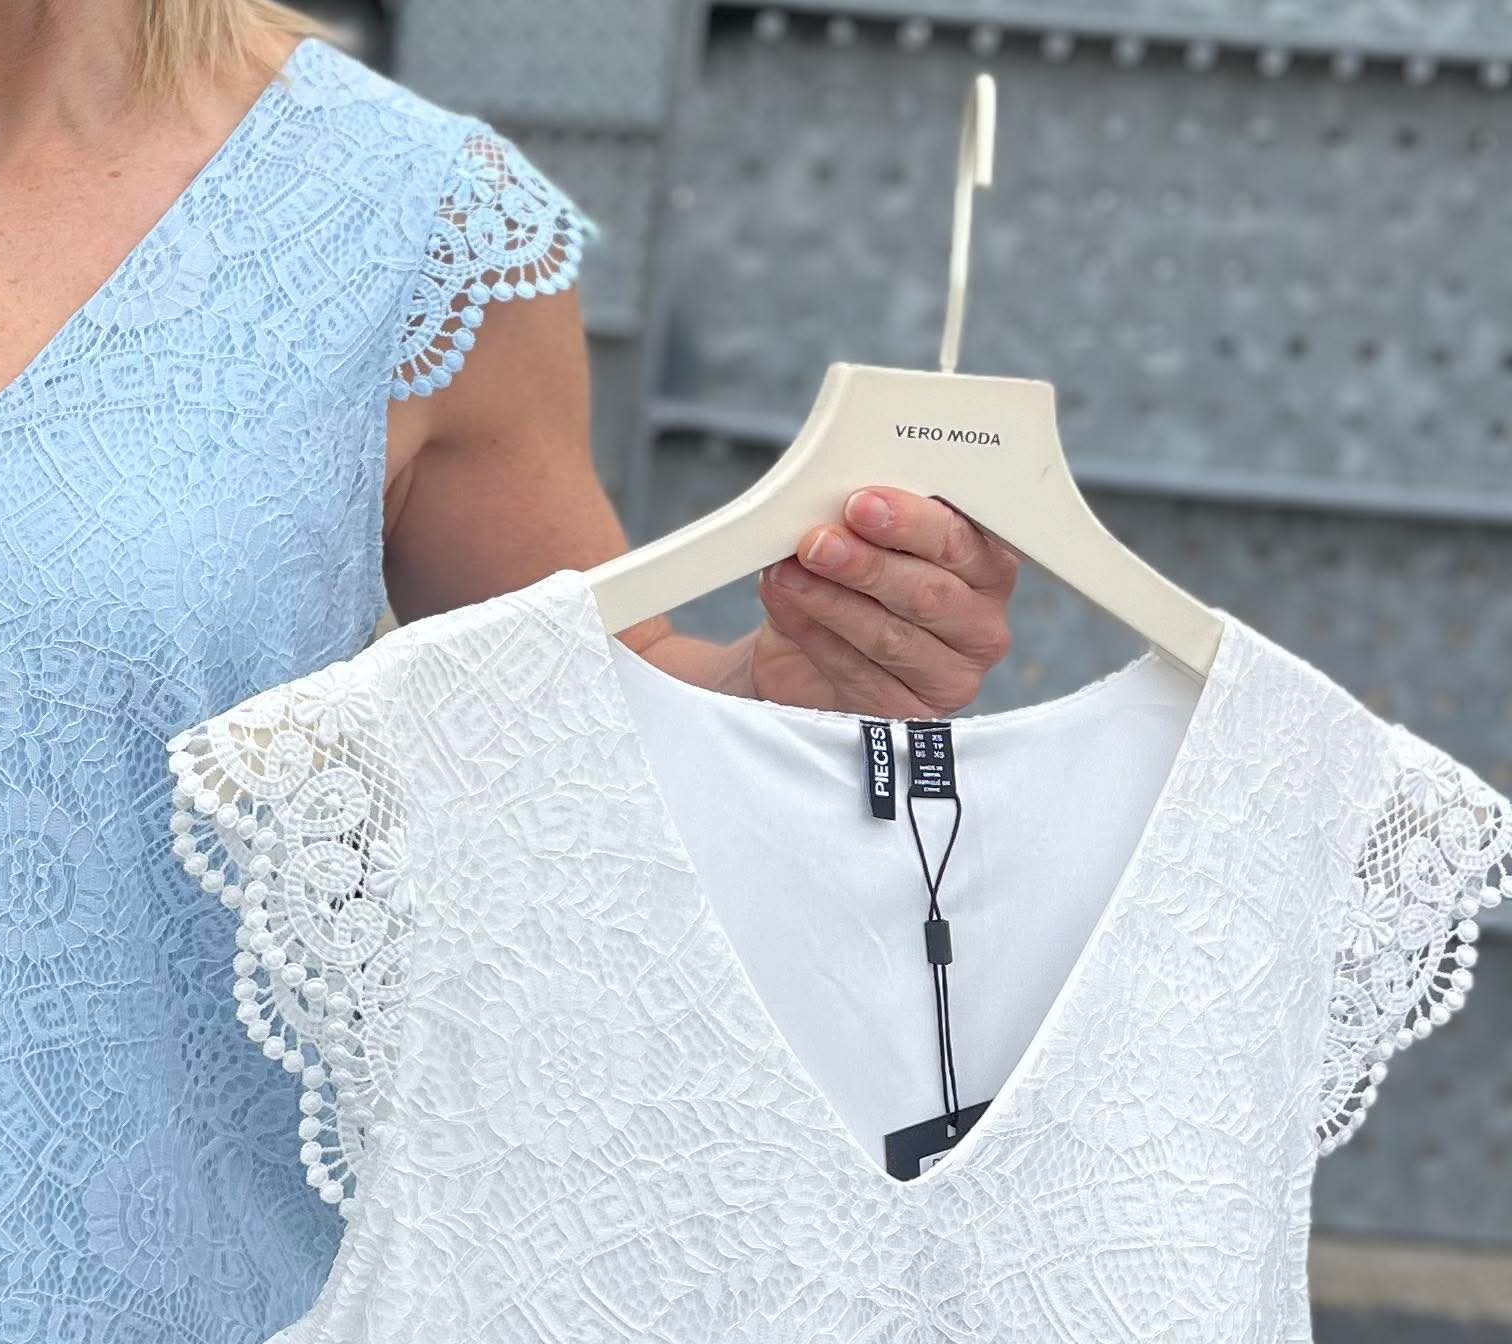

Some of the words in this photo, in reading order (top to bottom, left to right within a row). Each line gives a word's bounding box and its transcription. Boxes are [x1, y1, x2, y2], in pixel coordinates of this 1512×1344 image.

[895, 424, 943, 441] VERO
[947, 429, 1001, 446] MODA
[870, 727, 890, 797] PIECES
